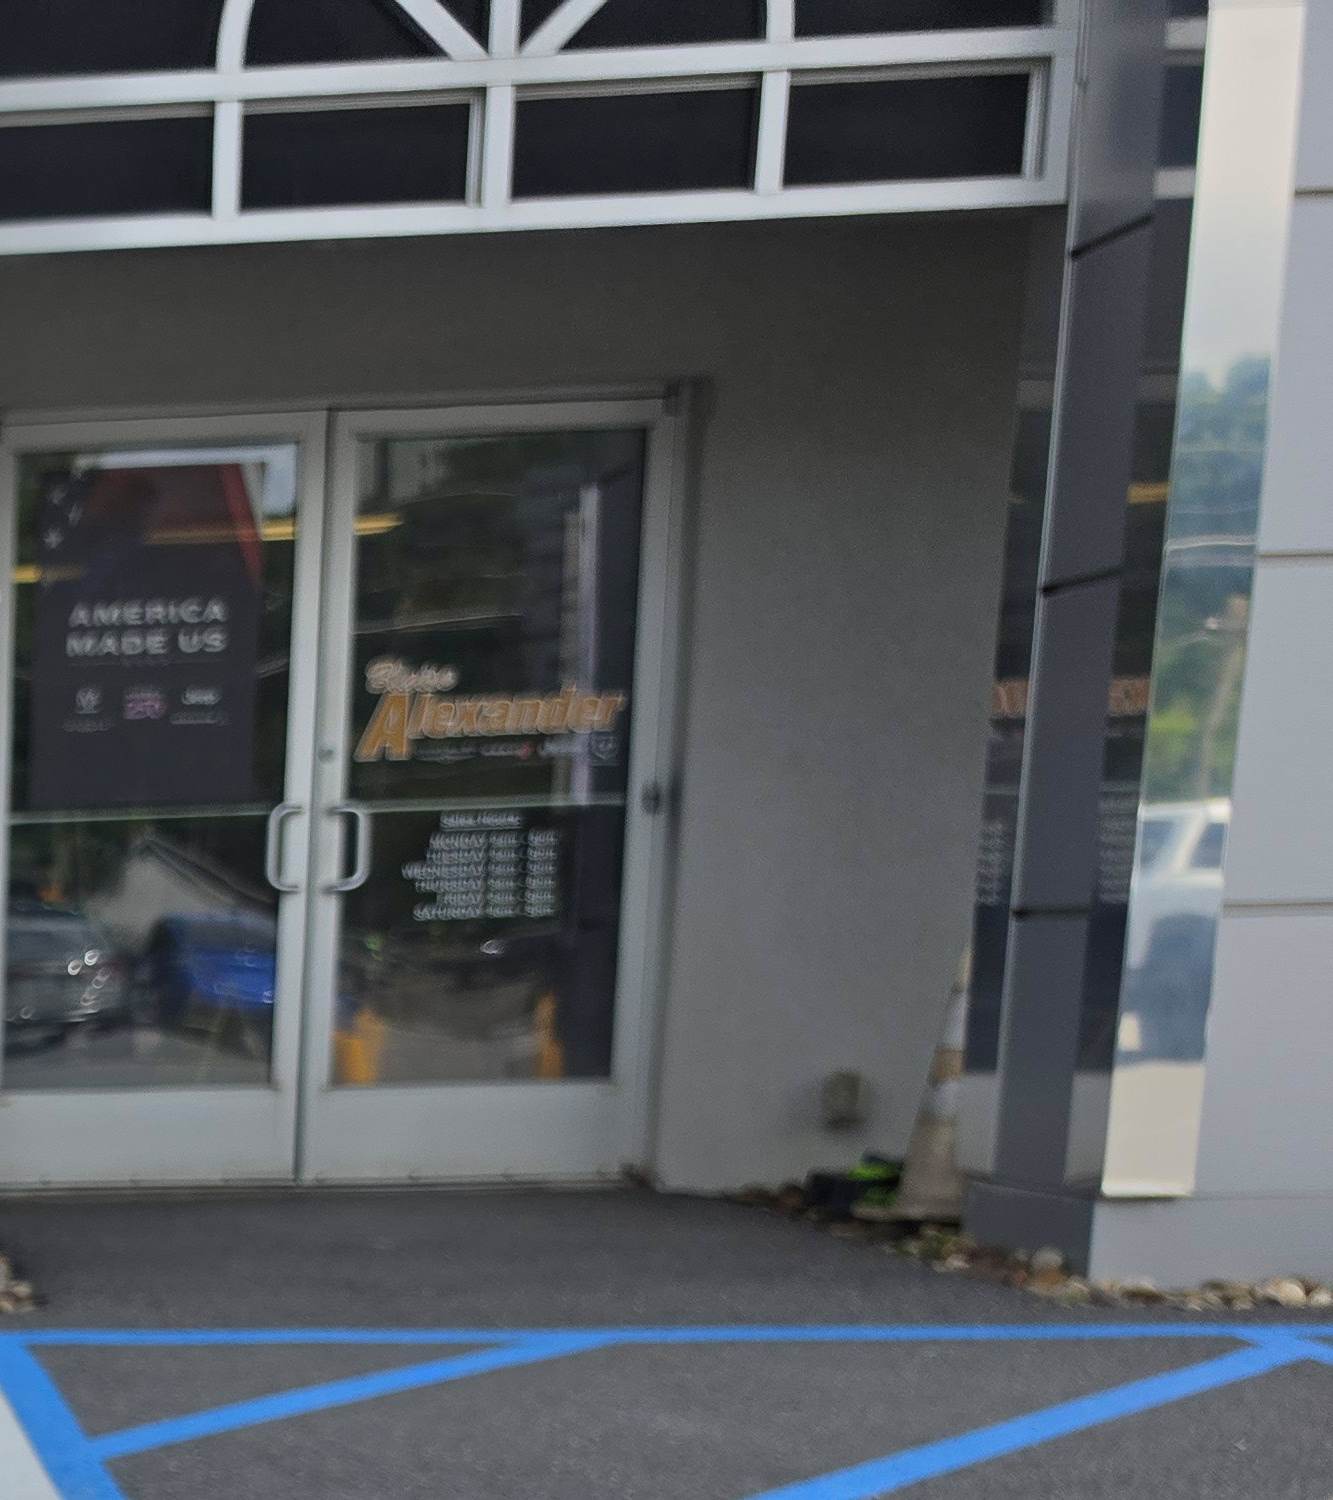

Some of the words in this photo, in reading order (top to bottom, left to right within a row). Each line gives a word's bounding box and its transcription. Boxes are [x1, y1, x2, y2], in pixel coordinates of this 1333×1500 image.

[68, 599, 228, 627] AMERICA
[66, 629, 171, 657] MADE
[177, 626, 228, 653] US
[355, 683, 626, 762] Alexander
